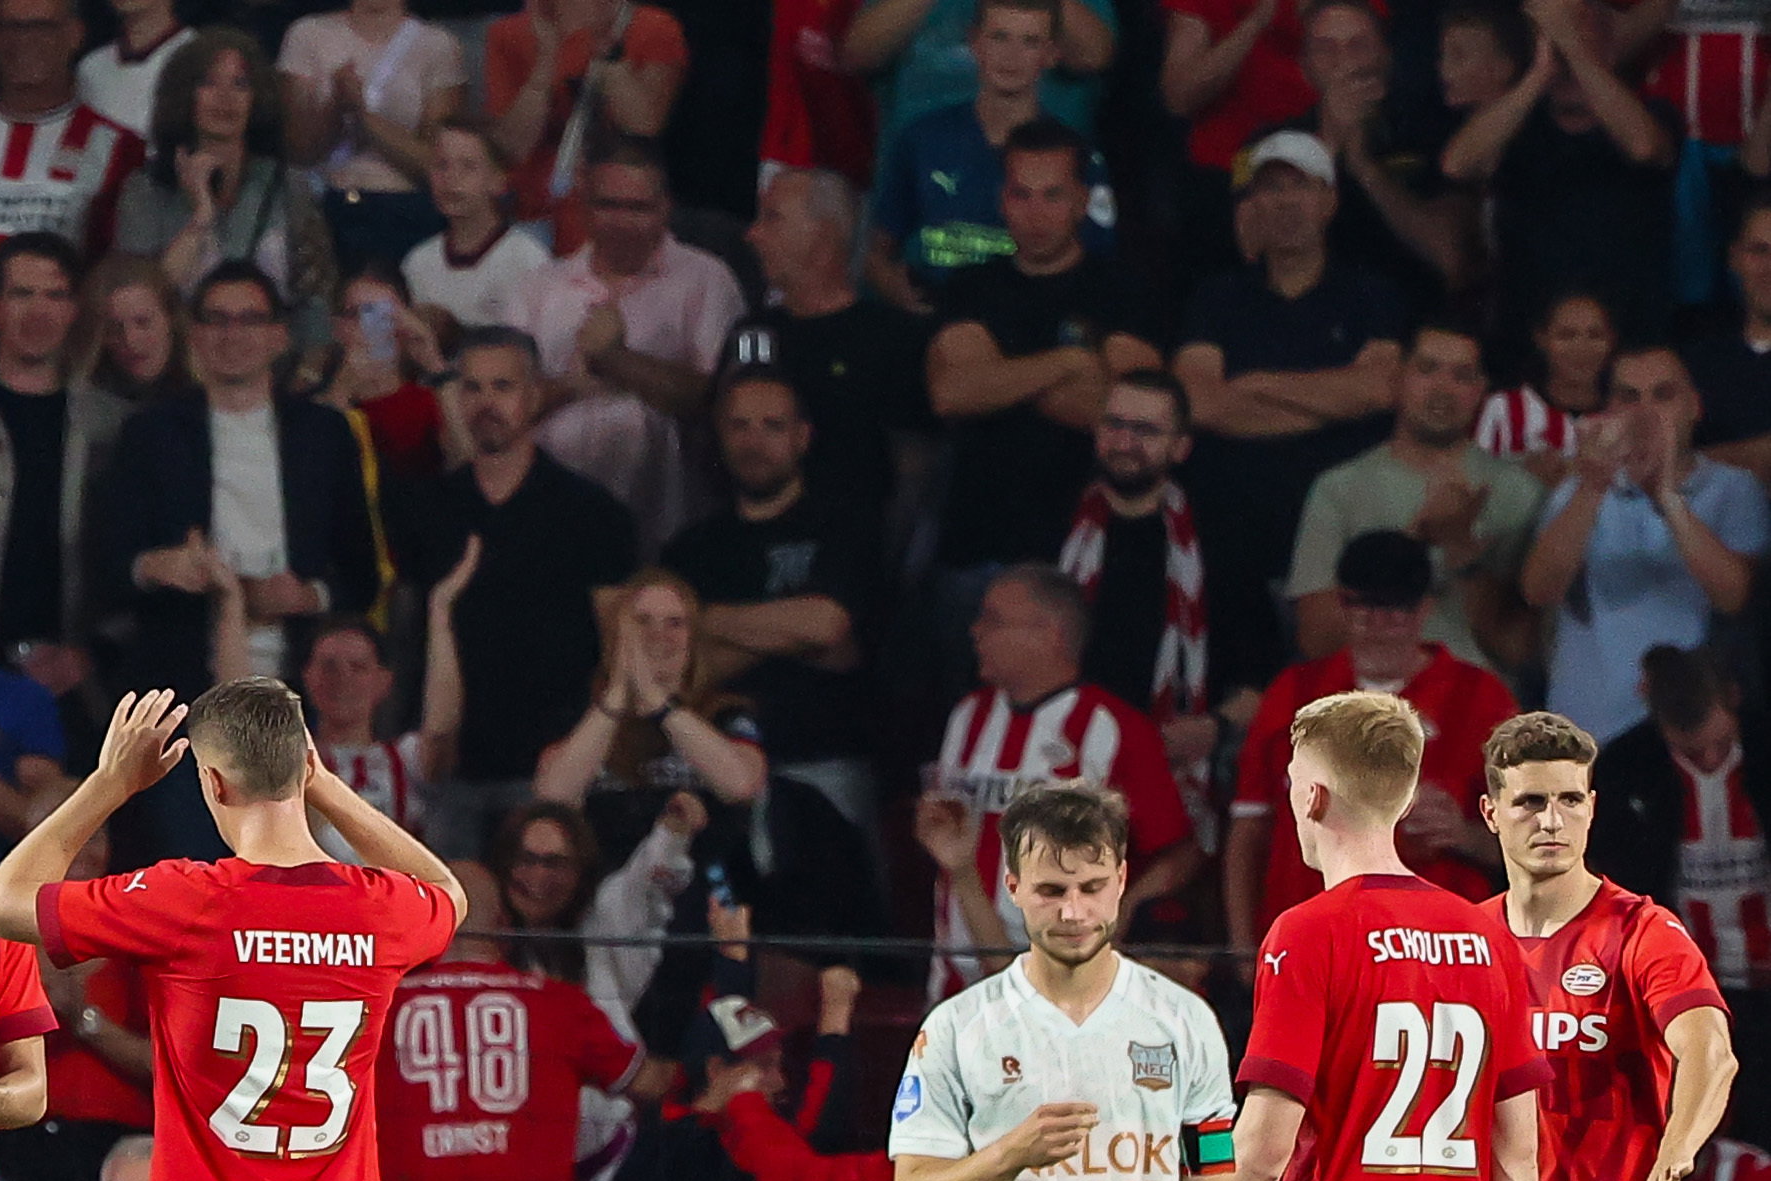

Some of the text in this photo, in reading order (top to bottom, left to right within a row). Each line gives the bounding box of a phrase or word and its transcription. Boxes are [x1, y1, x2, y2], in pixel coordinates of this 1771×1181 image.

[233, 930, 376, 967] VEERMAN
[1367, 928, 1492, 967] SCHOUTEN
[1532, 1012, 1609, 1052] IPS
[394, 994, 529, 1114] 48
[1136, 1062, 1170, 1077] NEC
[208, 997, 370, 1159] 23
[1361, 1001, 1491, 1177] 22
